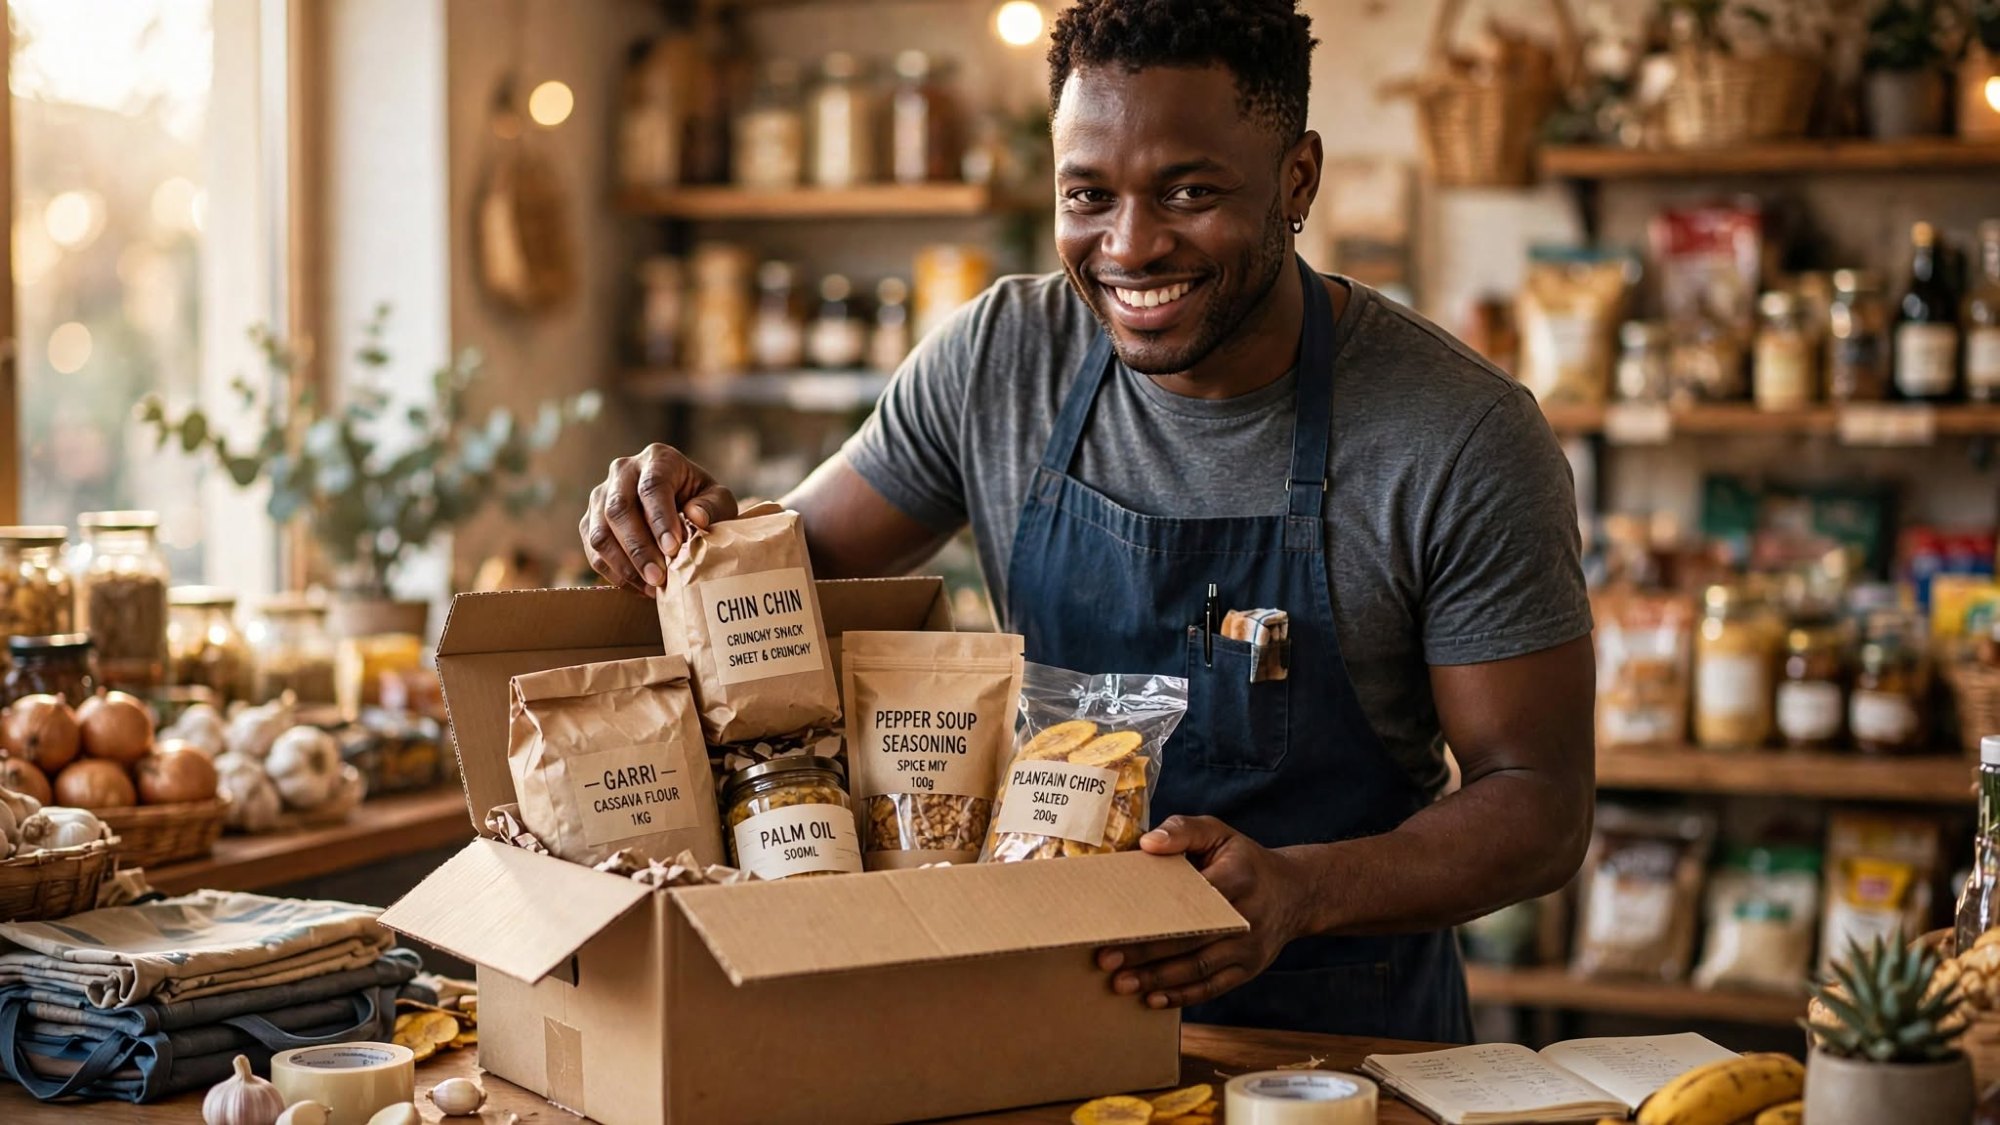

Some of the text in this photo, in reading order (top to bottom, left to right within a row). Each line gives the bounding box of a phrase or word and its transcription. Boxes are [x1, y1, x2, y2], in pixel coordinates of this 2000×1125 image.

[717, 589, 803, 623] CHIN CHIN
[876, 711, 977, 730] PEPPER SOUP
[882, 734, 967, 754] SEASONING
[897, 760, 925, 771] SPICE
[604, 764, 657, 790] GARRI
[911, 777, 934, 790] 100g
[1069, 775, 1106, 795] CHIPS
[594, 787, 680, 813] CASSAVA FLOUR
[1032, 791, 1069, 805] SALTED
[631, 811, 652, 826] 1KG
[1033, 809, 1057, 824] 200g
[760, 821, 836, 849] PALM OIL
